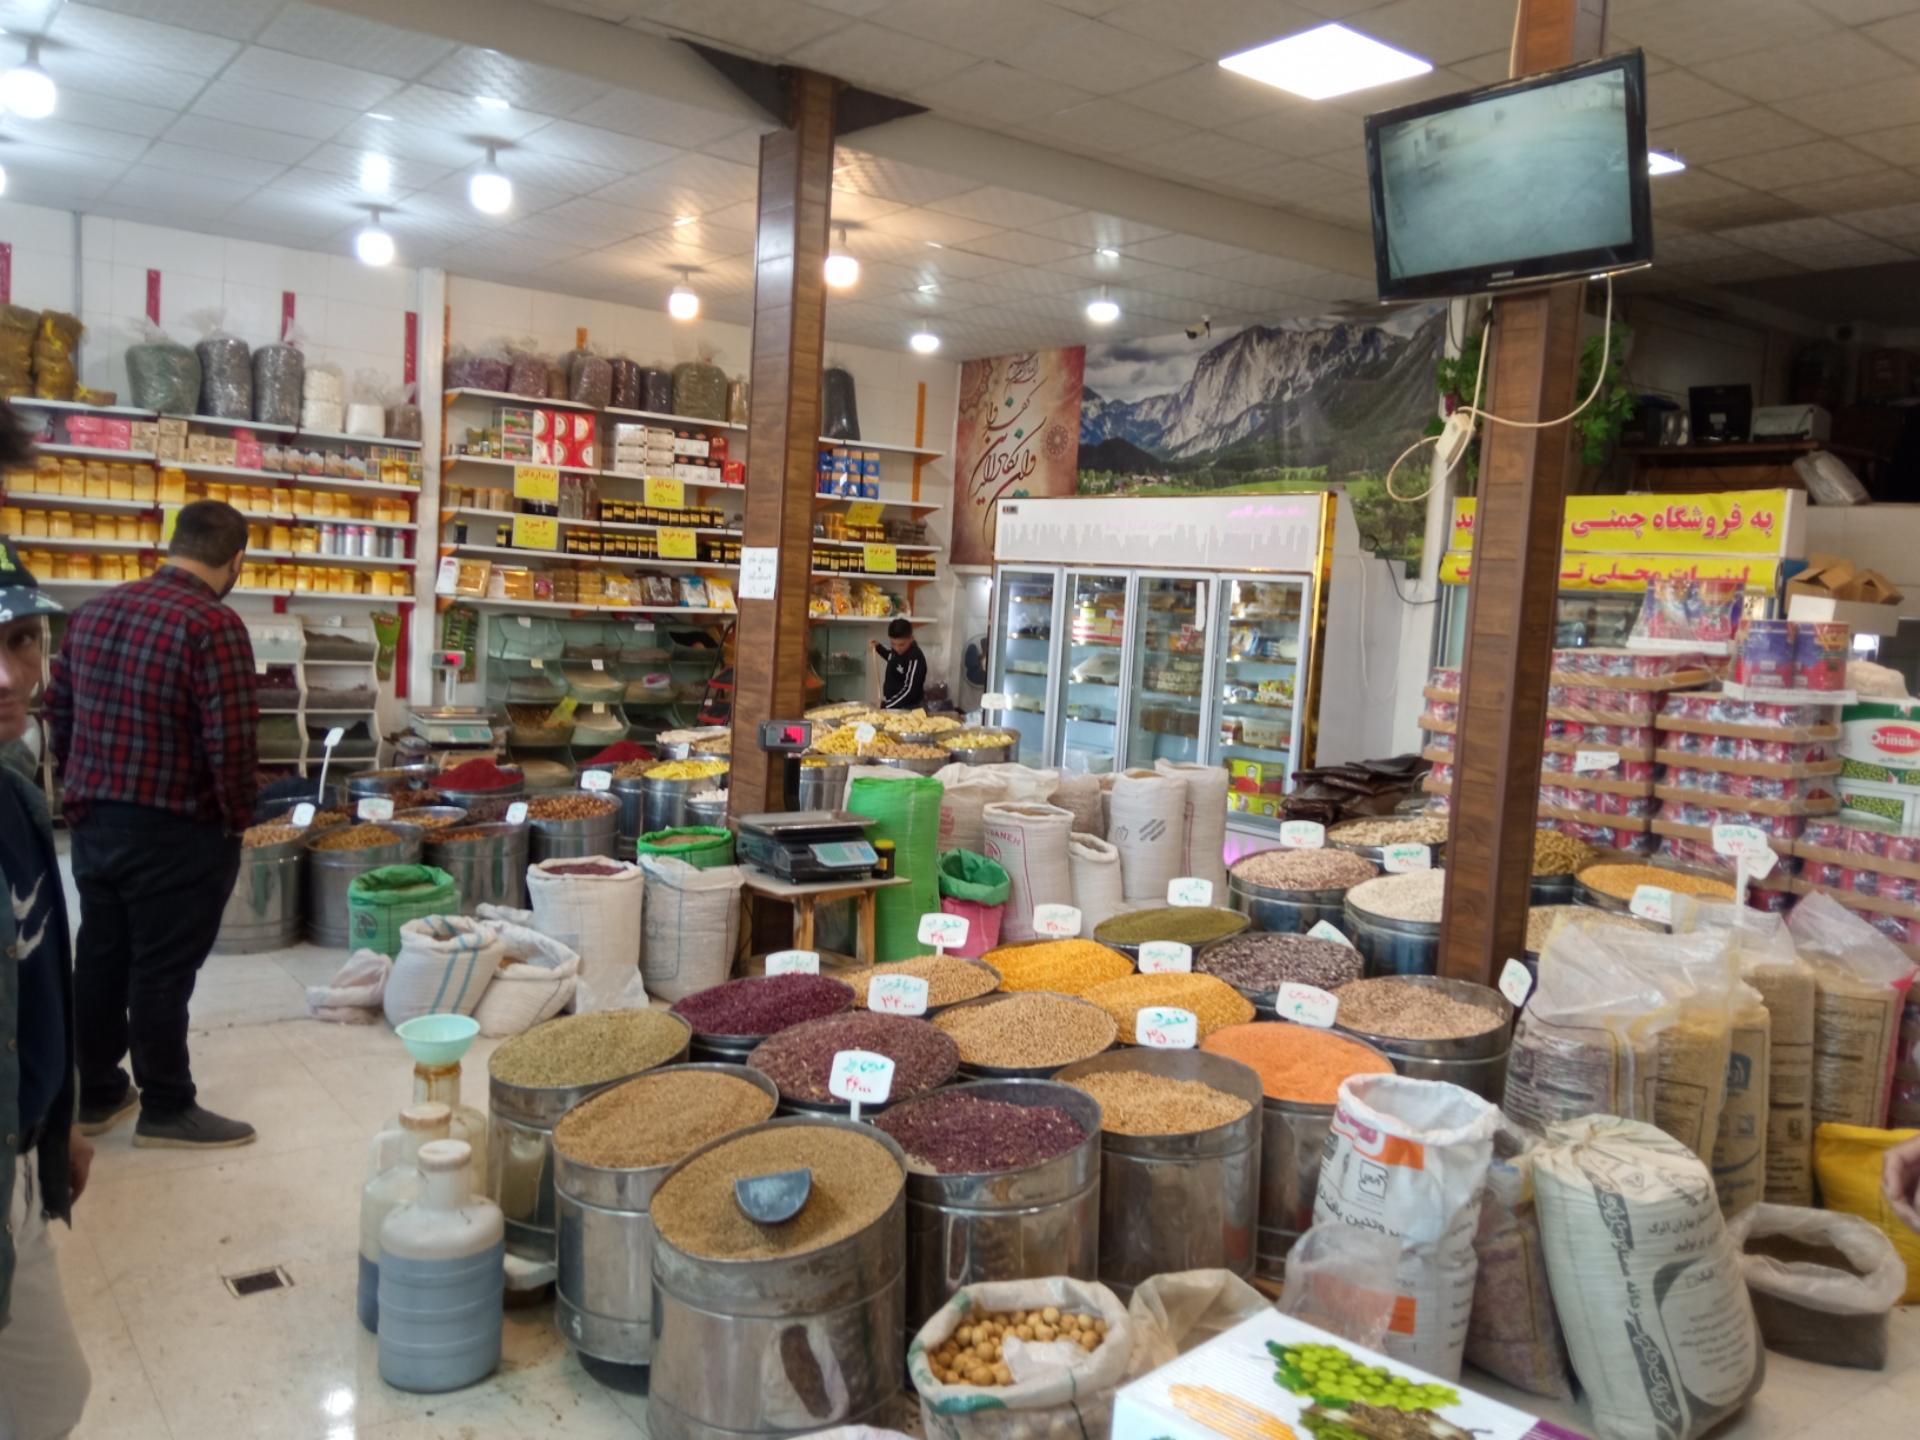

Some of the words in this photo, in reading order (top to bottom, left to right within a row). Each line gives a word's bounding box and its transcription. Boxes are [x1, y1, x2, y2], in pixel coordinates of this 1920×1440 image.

[1571, 506, 1647, 540] چمنی
[1652, 502, 1743, 539] فروشگاه
[1750, 507, 1774, 538] به
[1589, 562, 1659, 584] محلی
